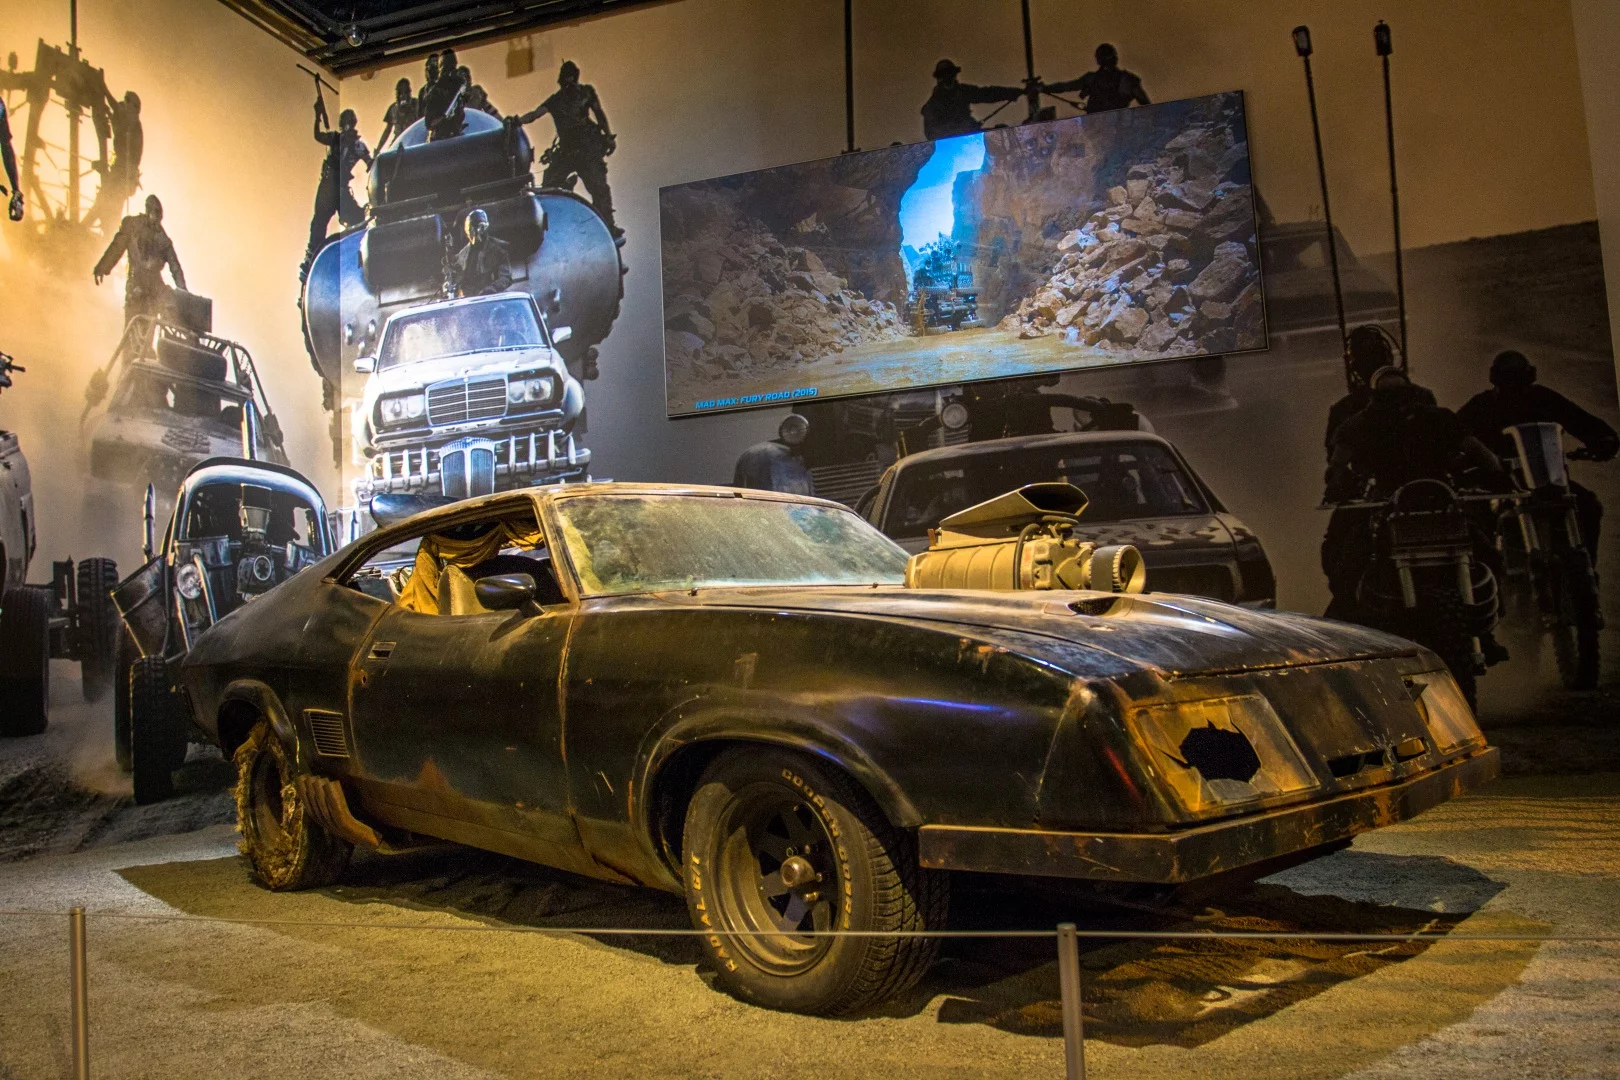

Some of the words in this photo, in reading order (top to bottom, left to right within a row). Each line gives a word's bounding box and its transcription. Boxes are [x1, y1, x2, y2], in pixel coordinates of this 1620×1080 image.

[695, 401, 716, 409] MAD
[717, 397, 740, 407] MAX:
[740, 394, 764, 404] FURY
[765, 392, 790, 401] ROAD
[791, 387, 818, 398] (2015)
[781, 768, 839, 837] COOPER
[838, 845, 852, 929] COBRA
